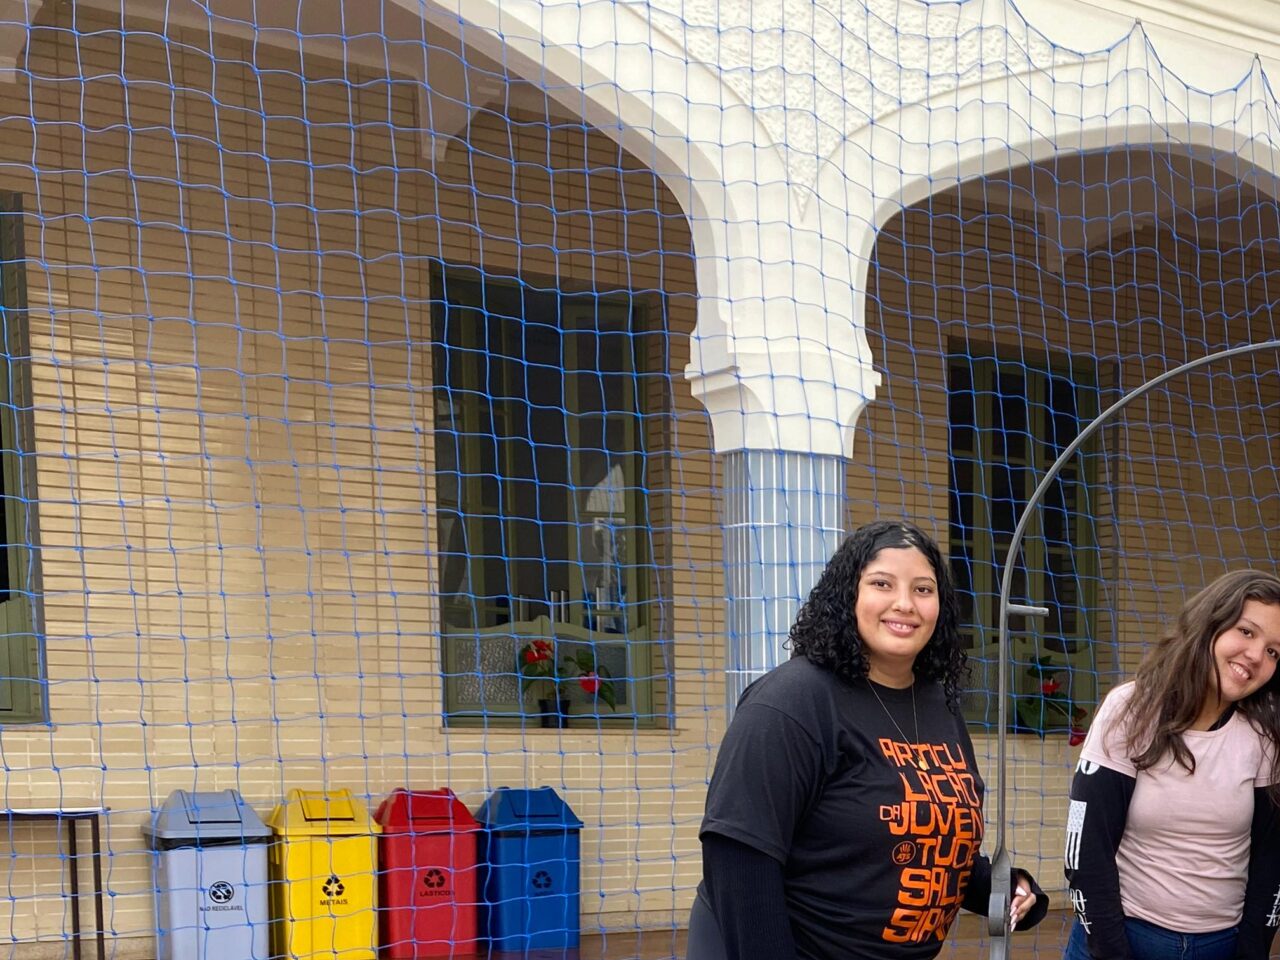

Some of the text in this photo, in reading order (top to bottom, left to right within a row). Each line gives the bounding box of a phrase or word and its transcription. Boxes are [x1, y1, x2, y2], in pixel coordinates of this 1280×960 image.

[879, 738, 967, 771] ARTICU
[880, 801, 984, 839] DA JUVEN
[898, 867, 970, 906] SALE
